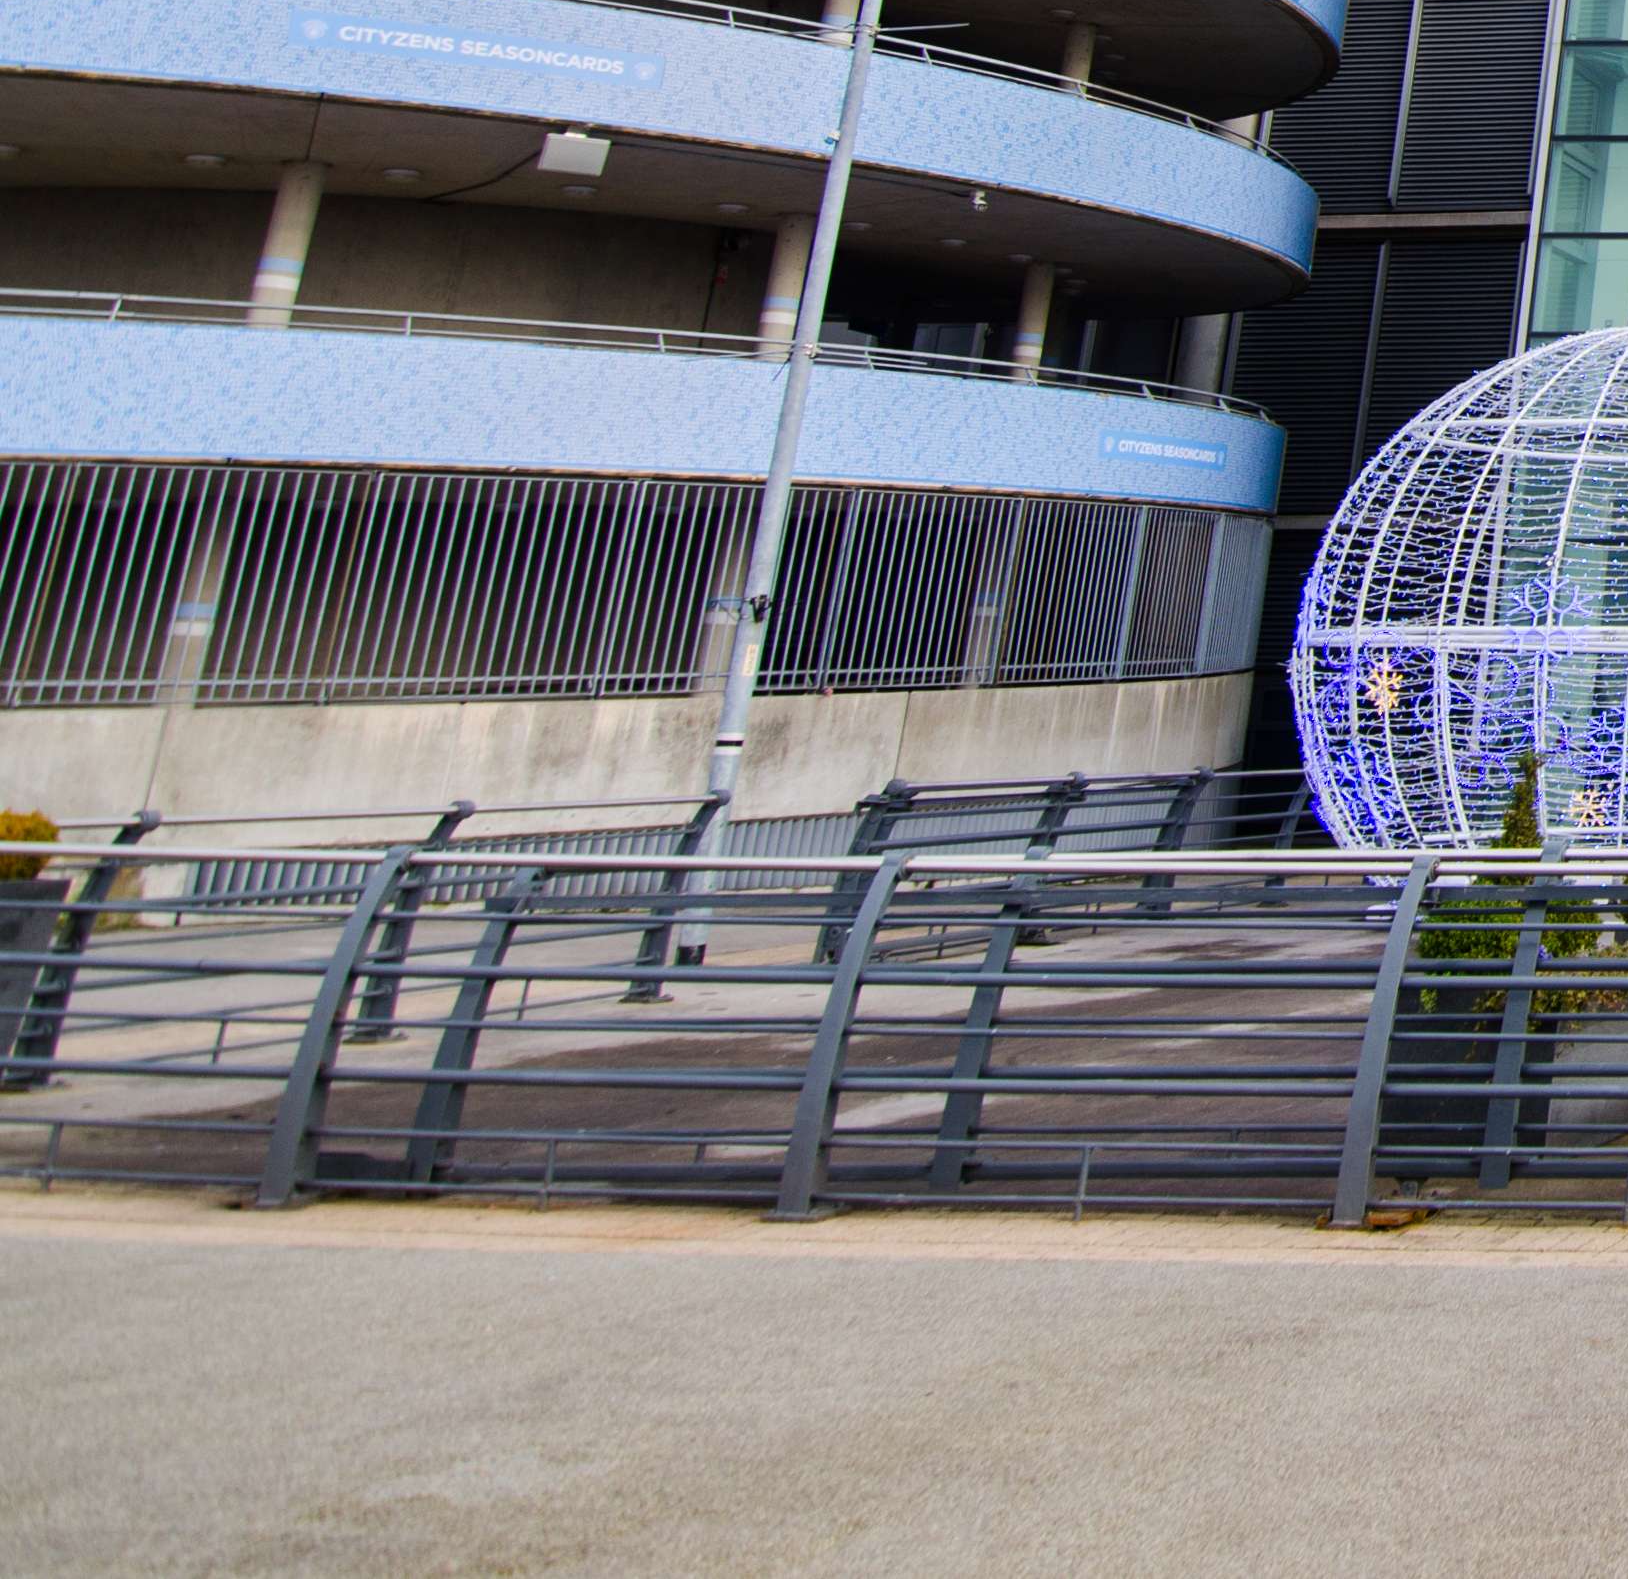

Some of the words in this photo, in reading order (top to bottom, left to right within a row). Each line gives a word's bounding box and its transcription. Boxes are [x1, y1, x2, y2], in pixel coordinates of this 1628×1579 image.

[338, 25, 455, 53] CITYZENS
[459, 39, 625, 76] SEASONCARDS
[1118, 439, 1163, 457] CITYZENS
